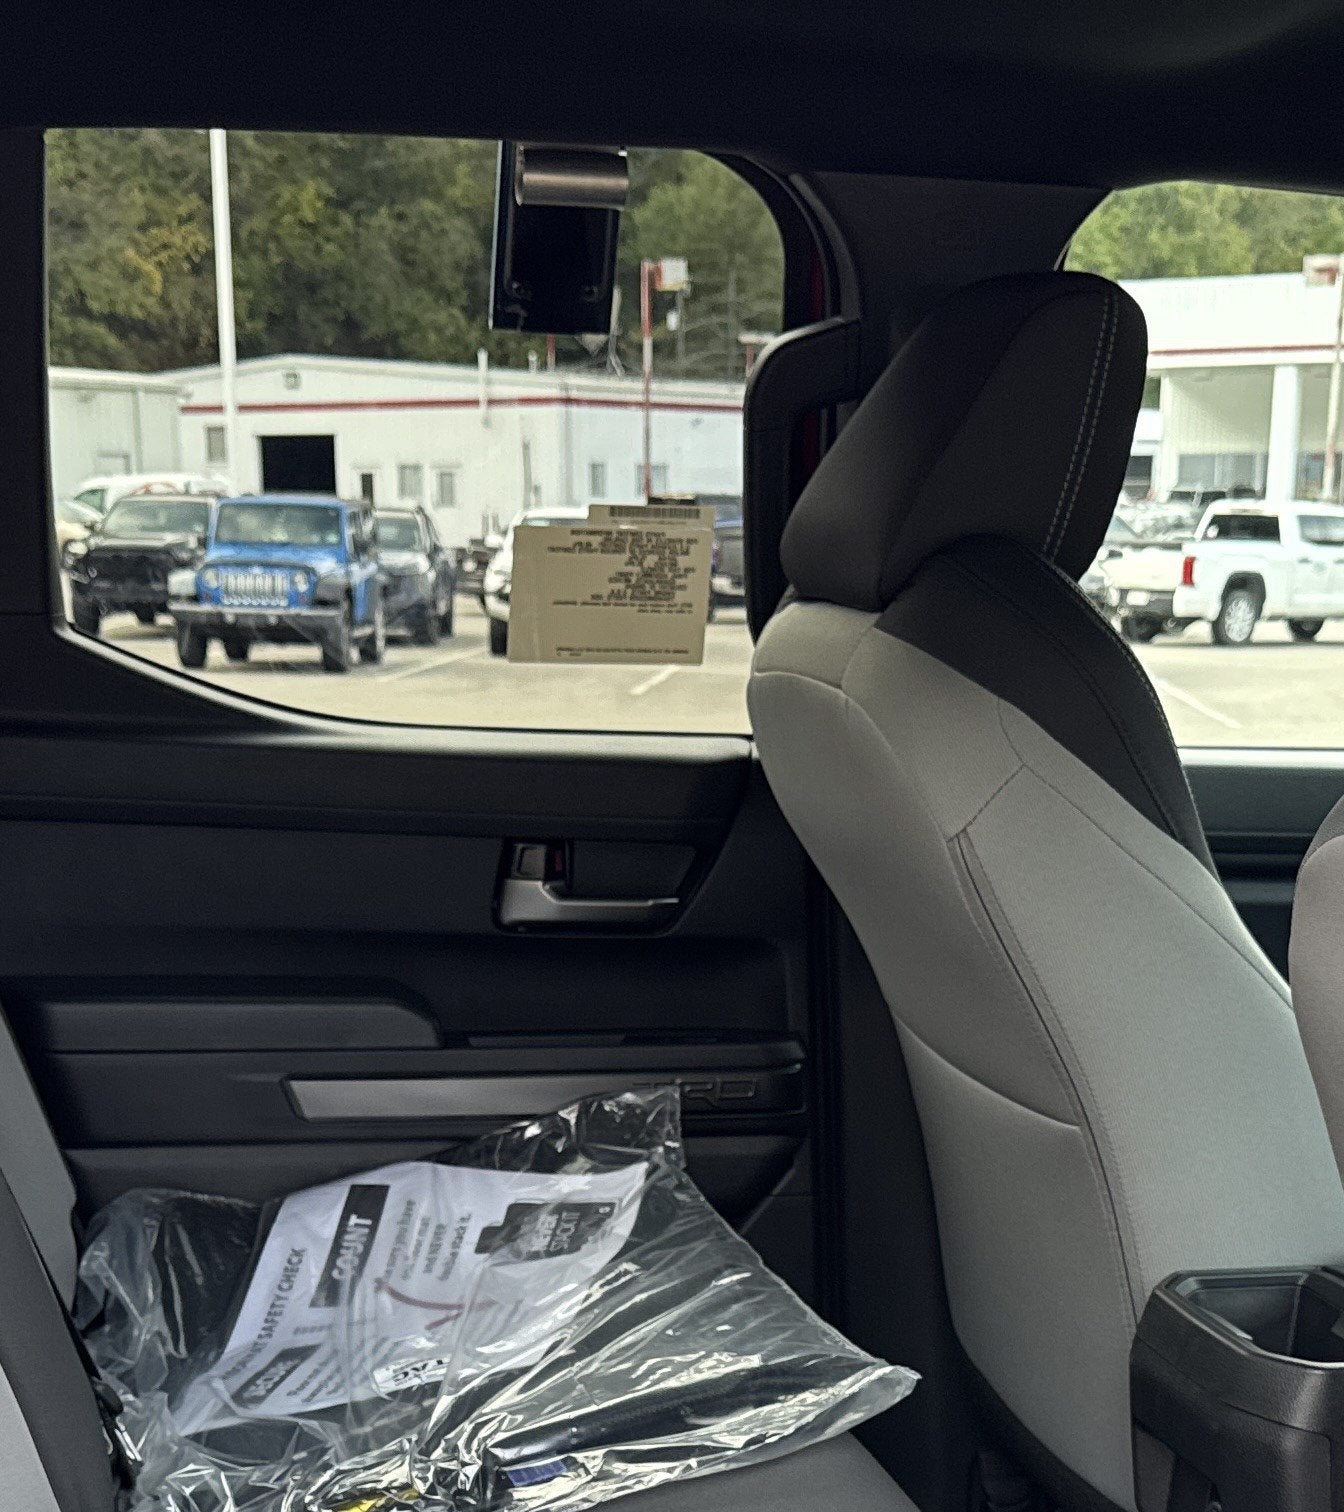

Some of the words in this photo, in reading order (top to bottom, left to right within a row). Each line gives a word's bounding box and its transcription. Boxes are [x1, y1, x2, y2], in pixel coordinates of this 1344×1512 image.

[332, 1213, 373, 1280] COUNT
[257, 1293, 290, 1340] SAFETY
[277, 1247, 306, 1292] CHECK
